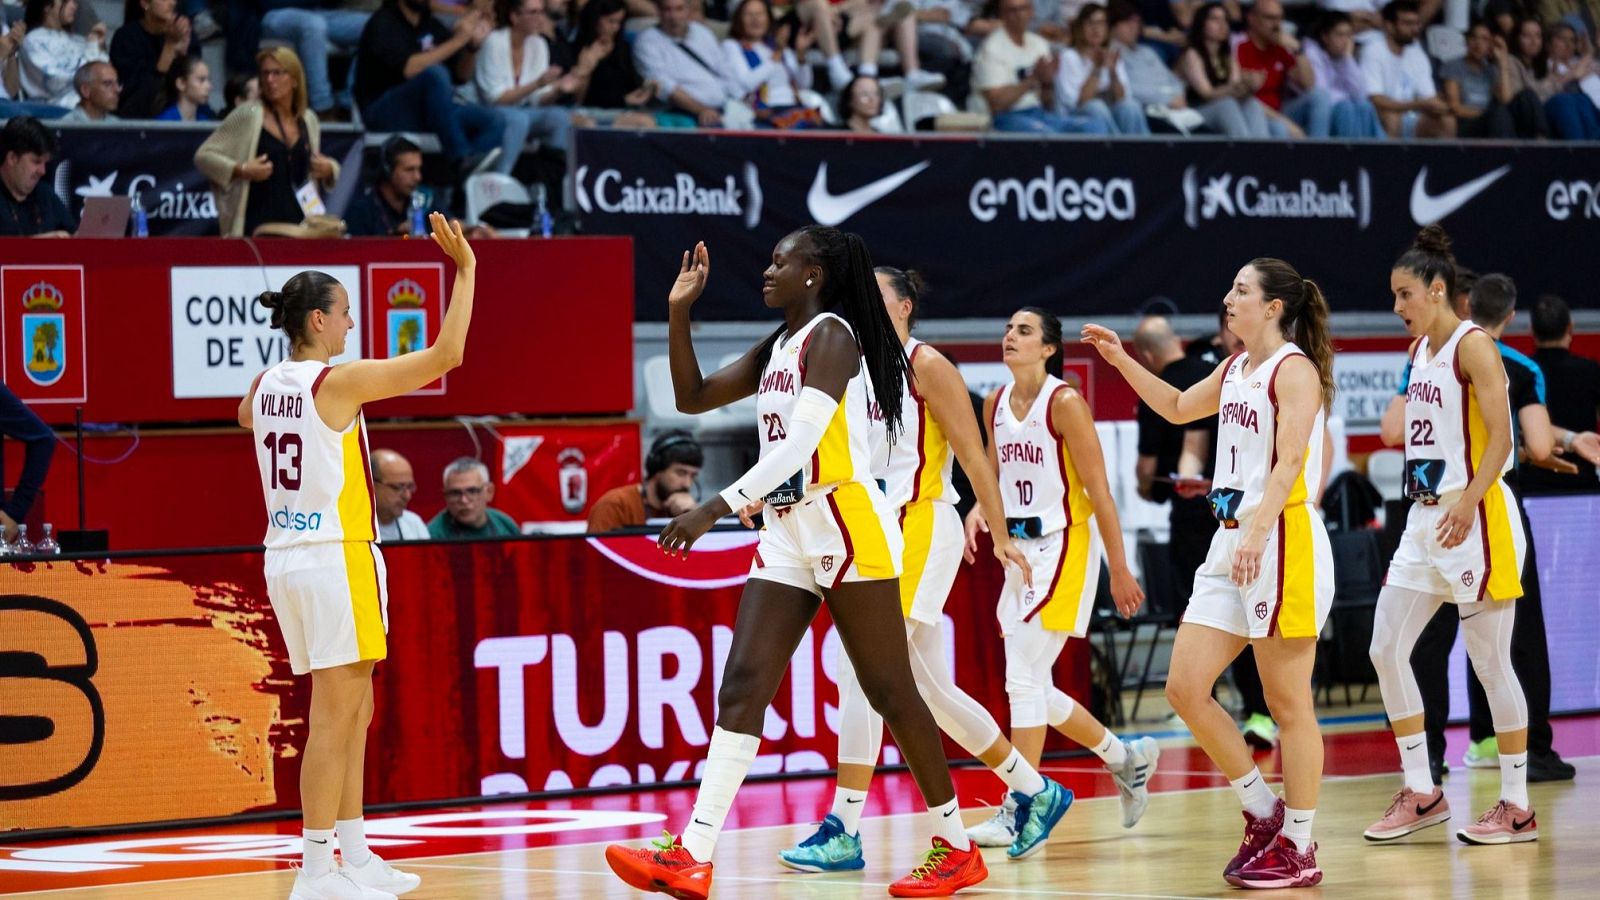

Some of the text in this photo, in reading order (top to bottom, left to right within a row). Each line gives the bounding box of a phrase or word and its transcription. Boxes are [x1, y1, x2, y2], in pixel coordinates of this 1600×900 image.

[128, 173, 219, 219] Caixa
[594, 168, 742, 216] CaixaBank
[969, 165, 1136, 222] endesa
[1235, 175, 1356, 218] CaixaBank
[186, 295, 267, 326] CONC
[207, 337, 284, 367] DE VI
[1338, 370, 1397, 392] CONCEL
[1405, 380, 1443, 409] SPAÑA
[261, 392, 303, 419] VILARÓ
[1222, 401, 1259, 434] SPAÑA
[763, 413, 787, 442] 23
[1410, 419, 1435, 446] 22
[263, 432, 303, 491] 13
[1000, 440, 1045, 468] SPAÑA
[1230, 445, 1238, 474] 1
[1015, 480, 1034, 505] 10
